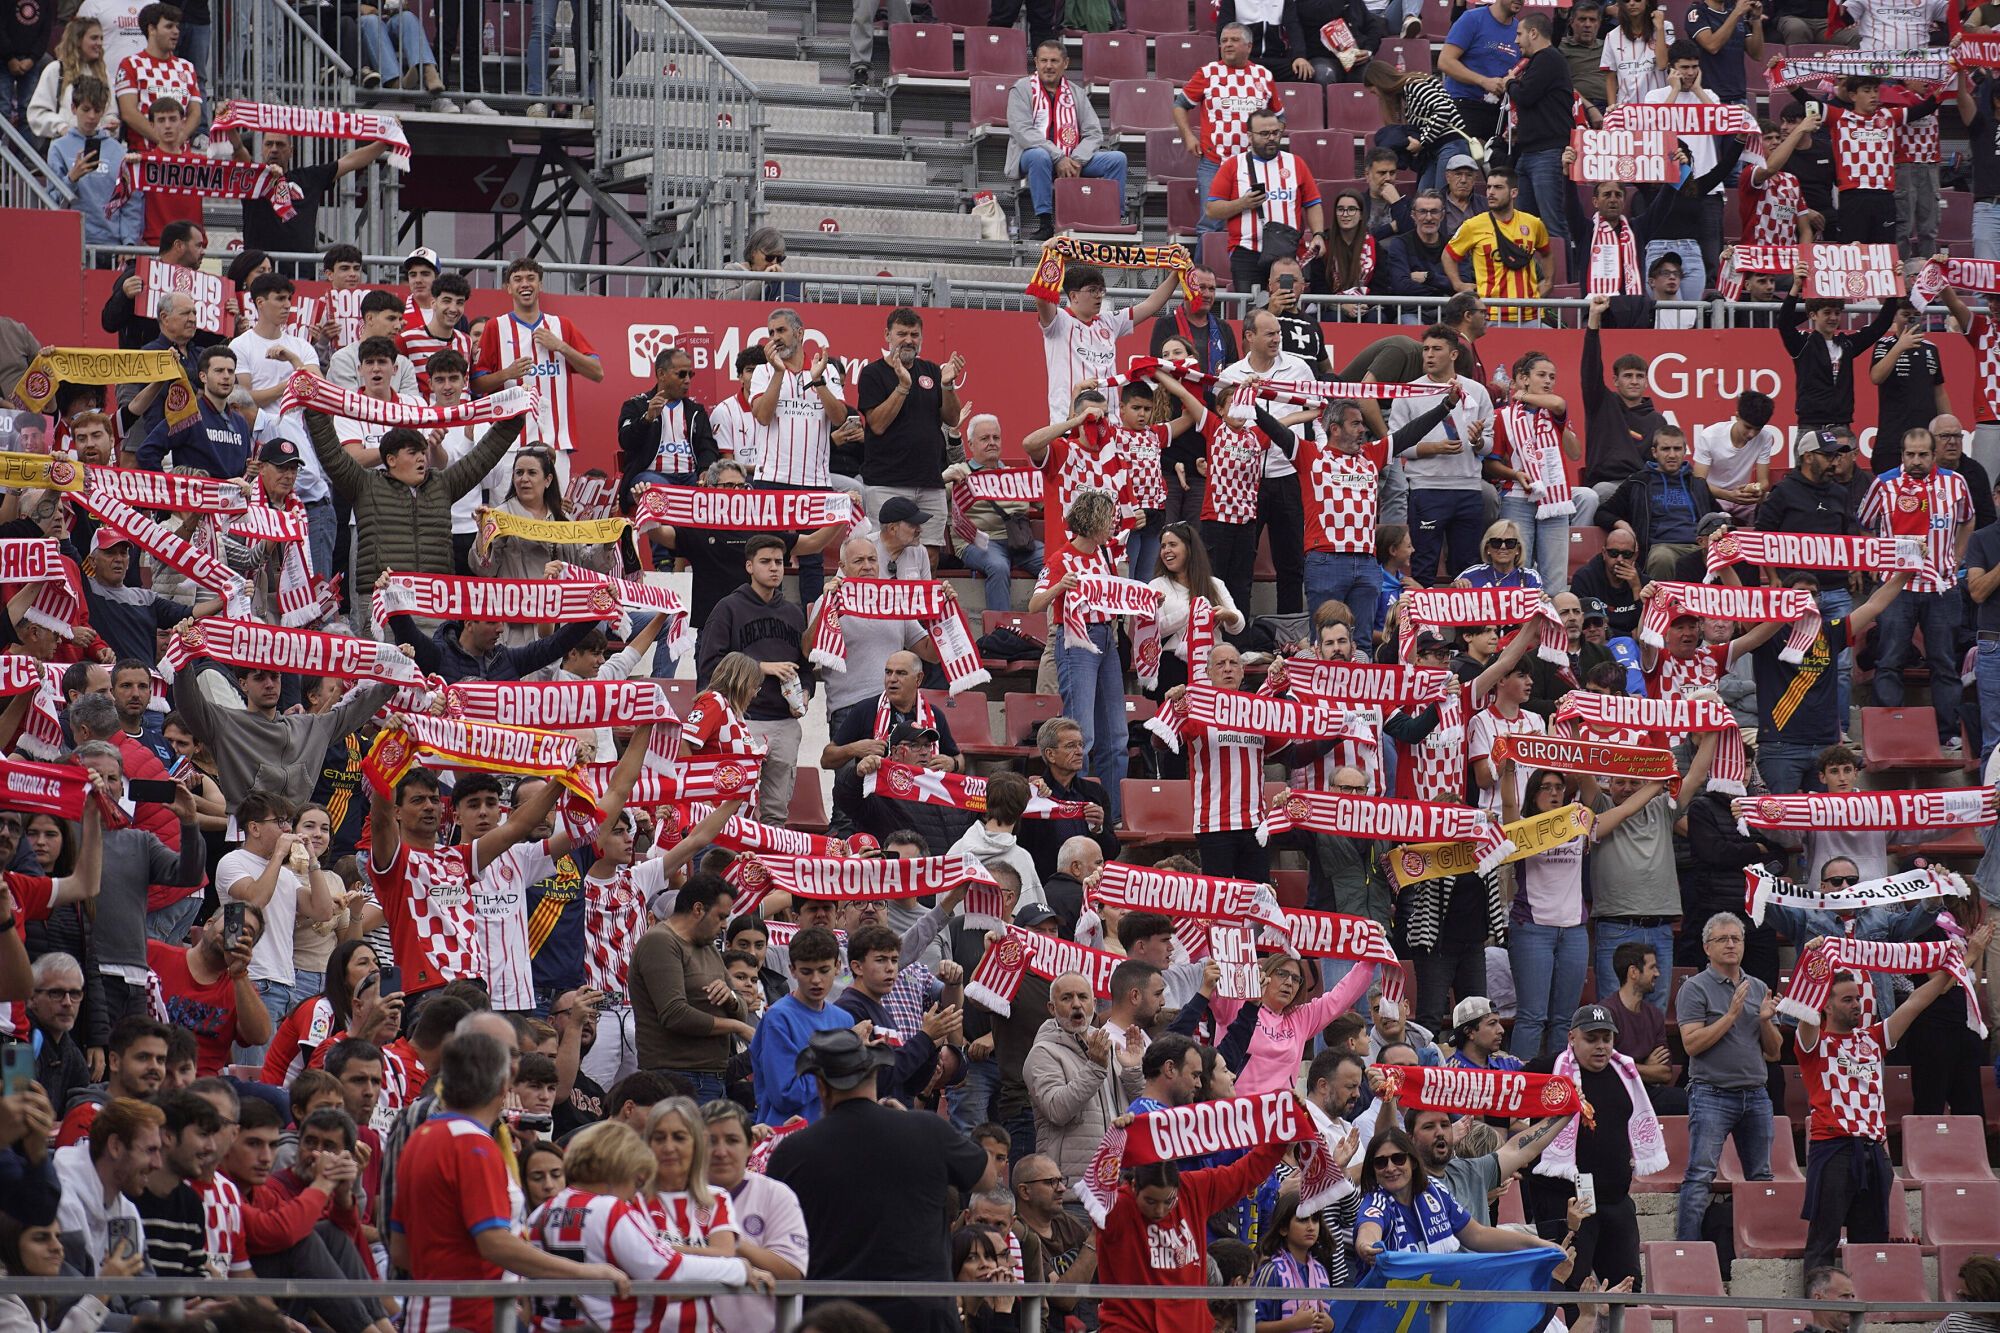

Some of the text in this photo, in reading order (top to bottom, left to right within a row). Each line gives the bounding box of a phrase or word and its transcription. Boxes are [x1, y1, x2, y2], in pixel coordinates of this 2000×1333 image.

[1618, 58, 1656, 70] ETIHA
[258, 103, 363, 136] GIRONA FC
[1623, 105, 1729, 133] GIRONA FC
[1583, 131, 1664, 153] SOM-HI
[145, 161, 256, 191] GIRONA FC
[765, 166, 778, 177] 18
[823, 223, 836, 232] 17
[1056, 239, 1181, 269] GIRONA FC
[1750, 247, 1773, 270] FC
[1813, 244, 1891, 270] SOM-HI
[53, 352, 150, 377] GIRONA
[694, 348, 709, 369] B
[1077, 348, 1114, 360] ETIHAD
[1295, 380, 1378, 399] GIRONA
[1648, 353, 1782, 400] Grup
[345, 391, 474, 420] GIRONA FC
[777, 400, 824, 410] ETIHAD
[206, 428, 234, 444] GIRONA
[658, 441, 693, 455] osb
[5, 457, 37, 482] FC
[89, 468, 203, 506] GIRONA FC
[969, 472, 1043, 499] GIRONA
[692, 491, 811, 526] GIRONA FC
[86, 490, 219, 582] GIRONA FC
[497, 512, 594, 543] GIRONA
[597, 516, 625, 539] FC
[1764, 534, 1880, 566] GIRONA FC
[432, 579, 561, 618] GIRONA FC
[845, 582, 926, 616] GIRONA
[1416, 589, 1525, 622] GIRONA FC
[1685, 586, 1796, 618] GIRONA FC
[740, 616, 802, 652] ABERCROMB
[231, 629, 360, 674] GIRONA FC
[1311, 664, 1430, 700] GIRONA FC
[497, 683, 637, 726] GIRONA FC
[1214, 693, 1329, 735] GIRONA FC
[1601, 694, 1725, 728] GIRONA FC
[402, 713, 578, 767] GIRONA FUTBOL CLU
[1218, 734, 1242, 744] ORGULL
[1517, 742, 1611, 767] GIRONA FC
[1613, 752, 1669, 767] Una temporada
[7, 771, 61, 798] GIRONA FC
[324, 768, 362, 782] ETIHAD
[1628, 765, 1667, 776] de primera
[1336, 798, 1458, 837] GIRONA FC
[1809, 794, 1929, 826] GIRONA FC
[761, 826, 812, 855] ORGULL
[1536, 815, 1568, 846] FC
[795, 855, 943, 897] GIRONA FC
[471, 894, 519, 905] TIHAD
[1125, 873, 1242, 915] GIRONA FC
[475, 907, 510, 915] AIRWAYS
[1211, 928, 1256, 963] SOM-H
[1338, 920, 1368, 956] FC
[1029, 935, 1100, 990] GIRONA
[1841, 938, 1924, 970] GIRONA
[1420, 1068, 1527, 1111] GIRONA FC
[1149, 1090, 1297, 1159] GIRONA FC
[1427, 1221, 1452, 1238] OVIED
[1430, 1213, 1448, 1226] REAL
